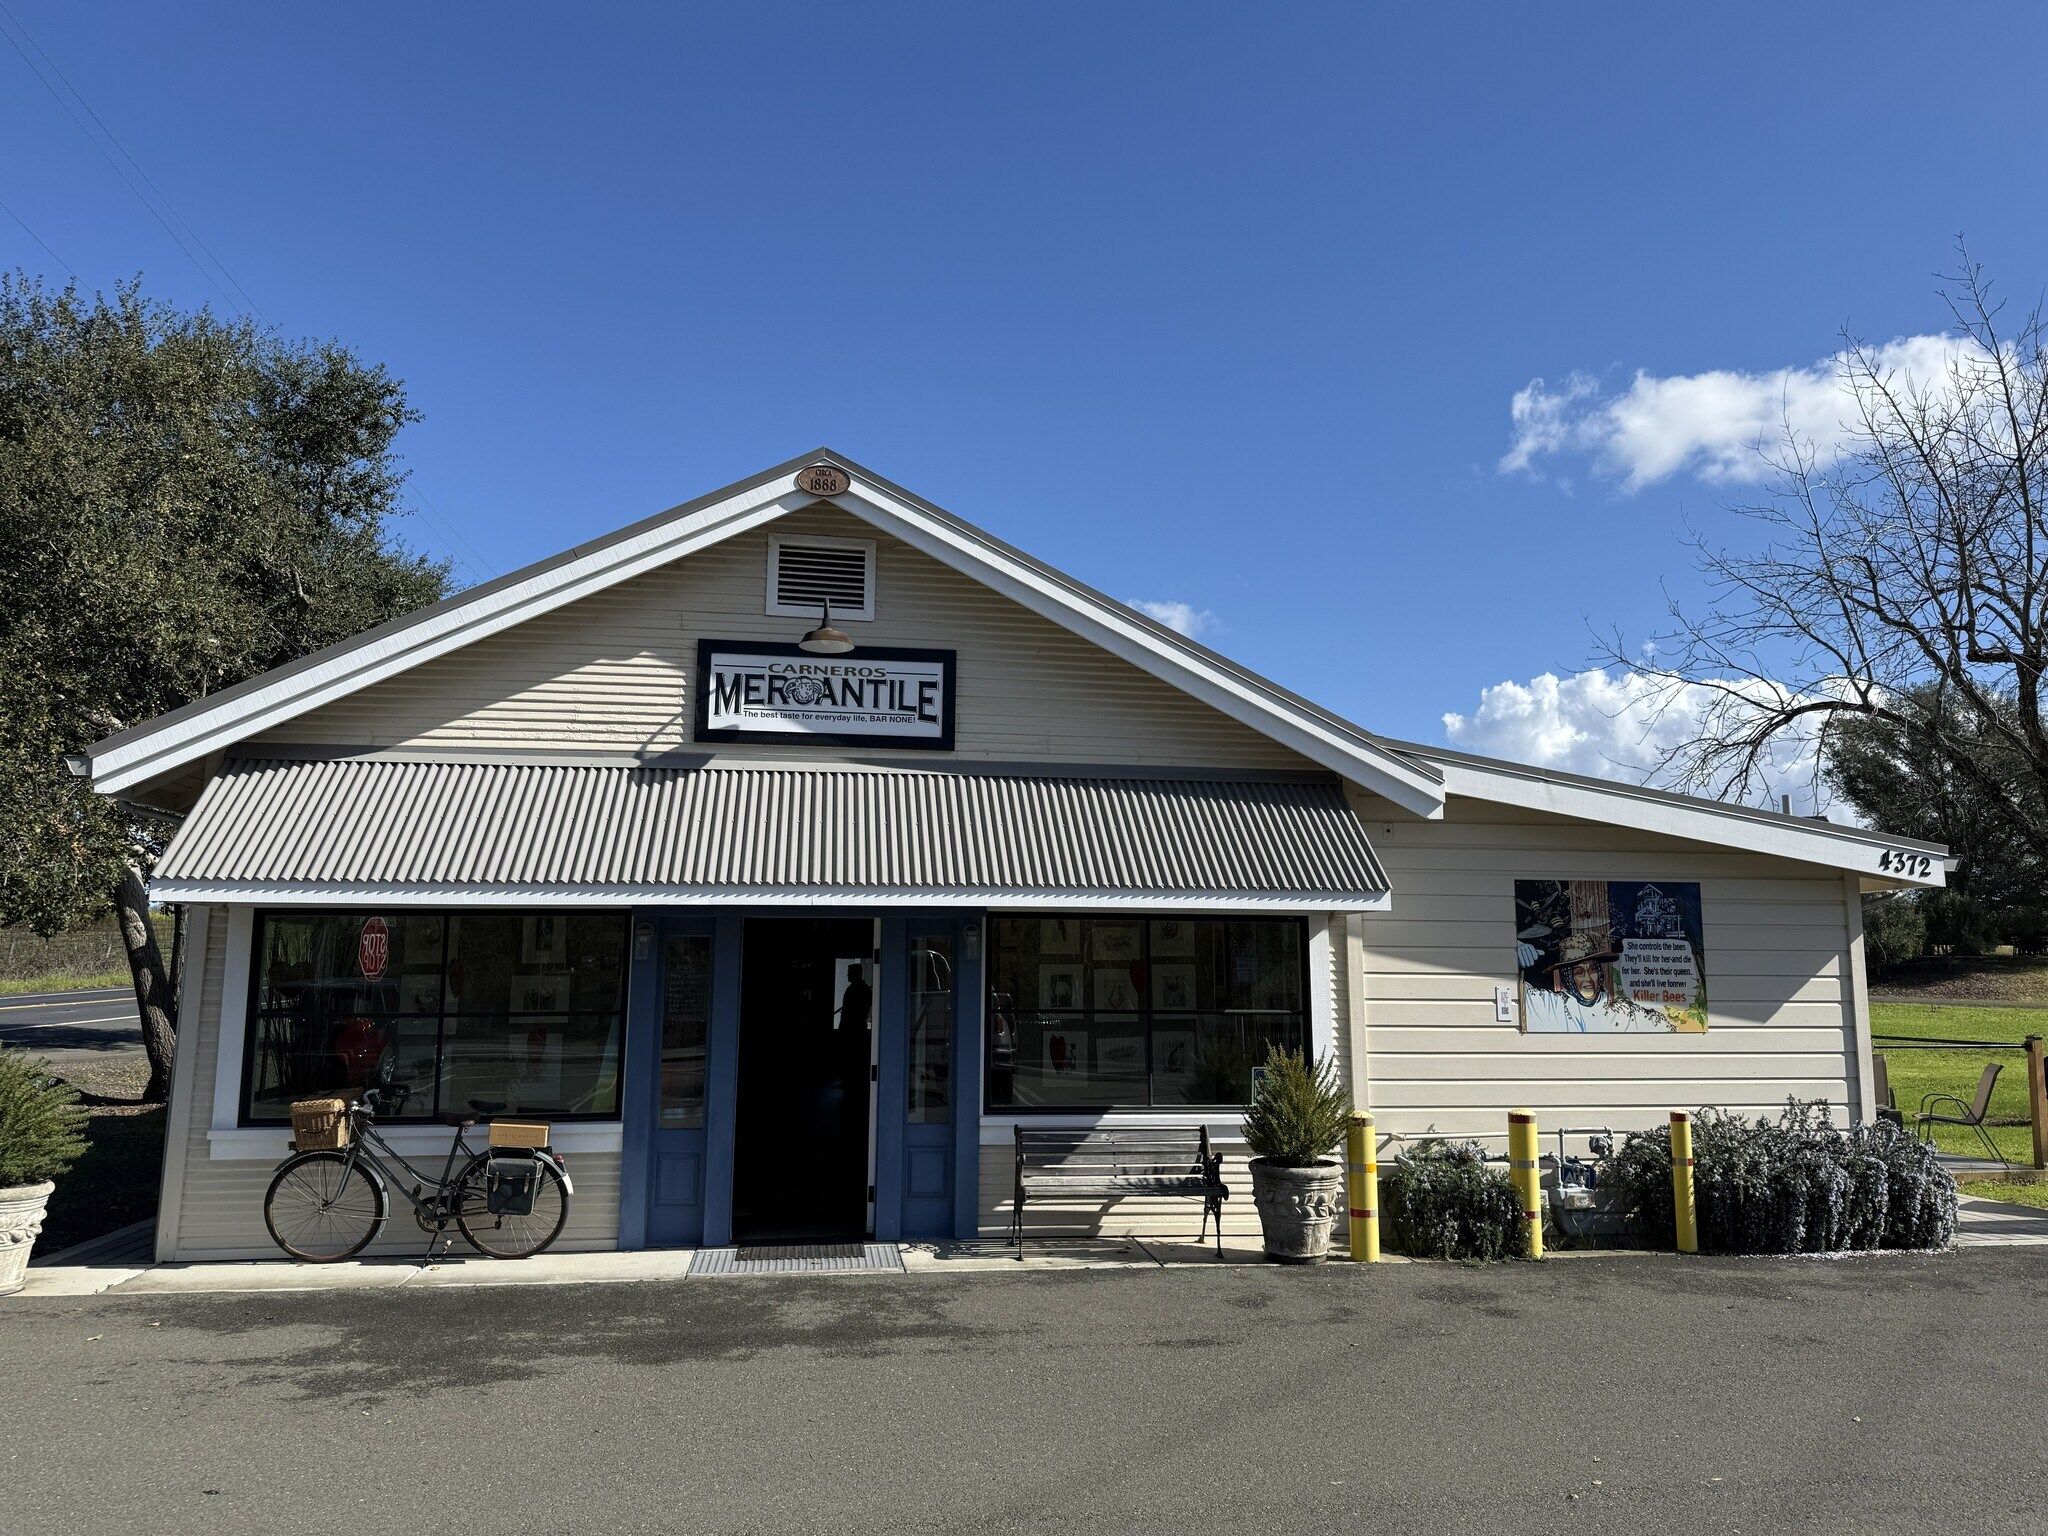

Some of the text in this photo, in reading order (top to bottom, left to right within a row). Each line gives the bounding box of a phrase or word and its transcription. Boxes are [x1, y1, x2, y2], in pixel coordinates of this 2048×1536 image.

[810, 478, 837, 491] 1888
[768, 663, 887, 678] CARNEROS
[744, 710, 916, 724] The best taste for everyday life, BAR NONE!
[1878, 849, 1931, 878] 4372
[1627, 942, 1639, 950] She
[1639, 942, 1662, 951] controls
[1662, 942, 1672, 951] the
[1624, 954, 1643, 964] They'll
[1643, 954, 1652, 963] kill
[1652, 955, 1661, 963] for
[1683, 955, 1692, 963] die
[1621, 966, 1630, 975] for
[1630, 967, 1641, 975] her.
[1643, 966, 1659, 975] She's
[1660, 967, 1673, 976] their
[1629, 979, 1687, 988] and she'll live forever
[1633, 989, 1687, 1003] Killer Bees
